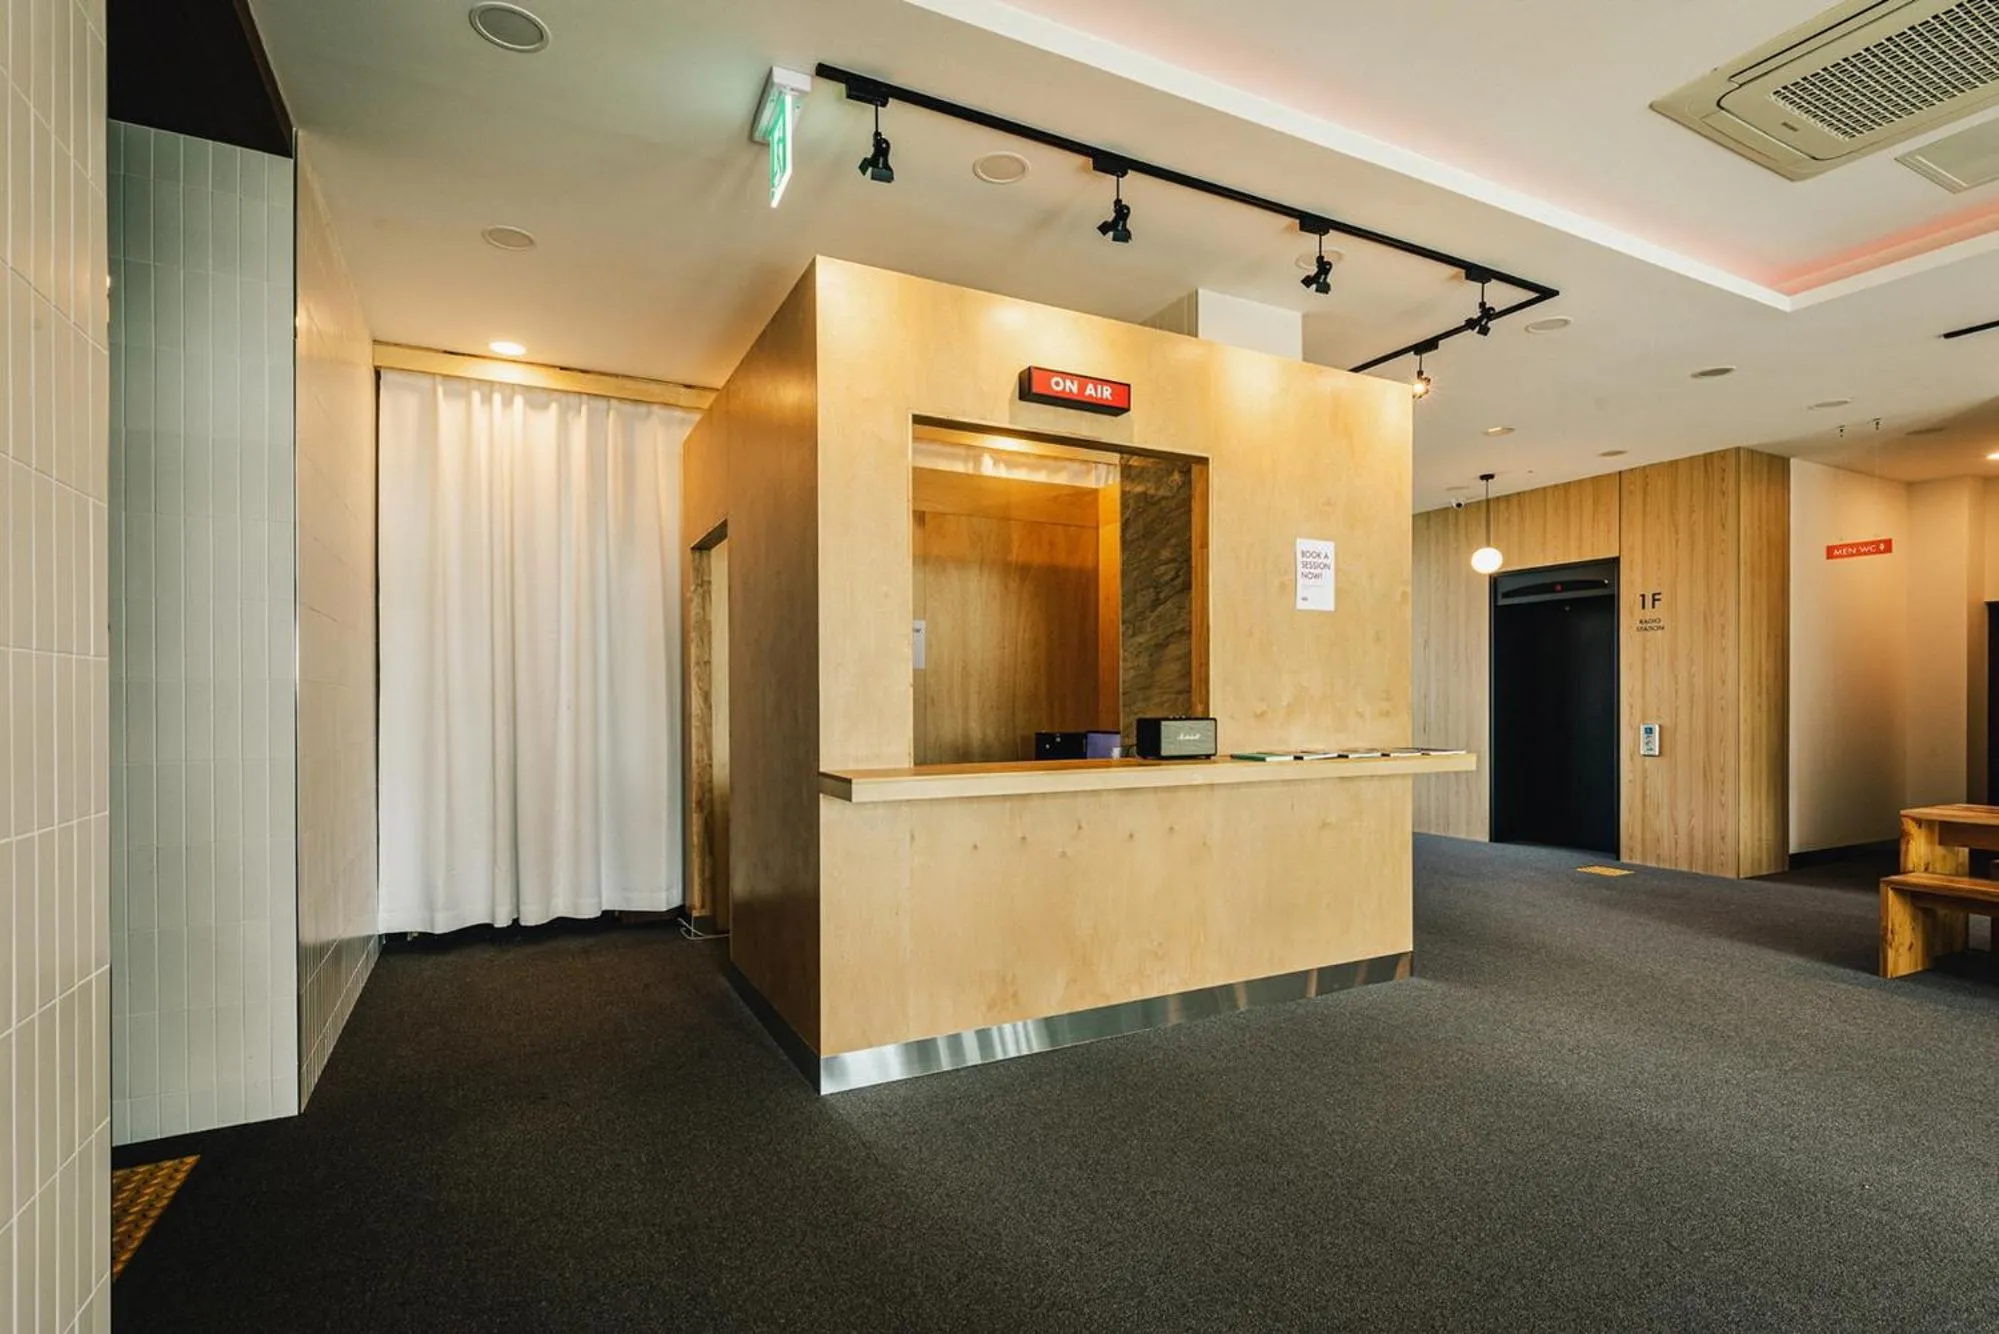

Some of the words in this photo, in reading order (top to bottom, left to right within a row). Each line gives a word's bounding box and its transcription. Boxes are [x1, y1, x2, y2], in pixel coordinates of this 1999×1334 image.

[1050, 376, 1078, 394] ON
[1085, 383, 1113, 400] AIR
[1301, 549, 1321, 559] BOOK
[1833, 547, 1857, 556] MEN
[1859, 544, 1876, 553] WC
[1301, 561, 1330, 570] SESSION
[1301, 571, 1323, 581] NOW!
[1639, 592, 1662, 610] 1F
[1639, 617, 1662, 625] RADIO
[1636, 625, 1665, 633] STATION
